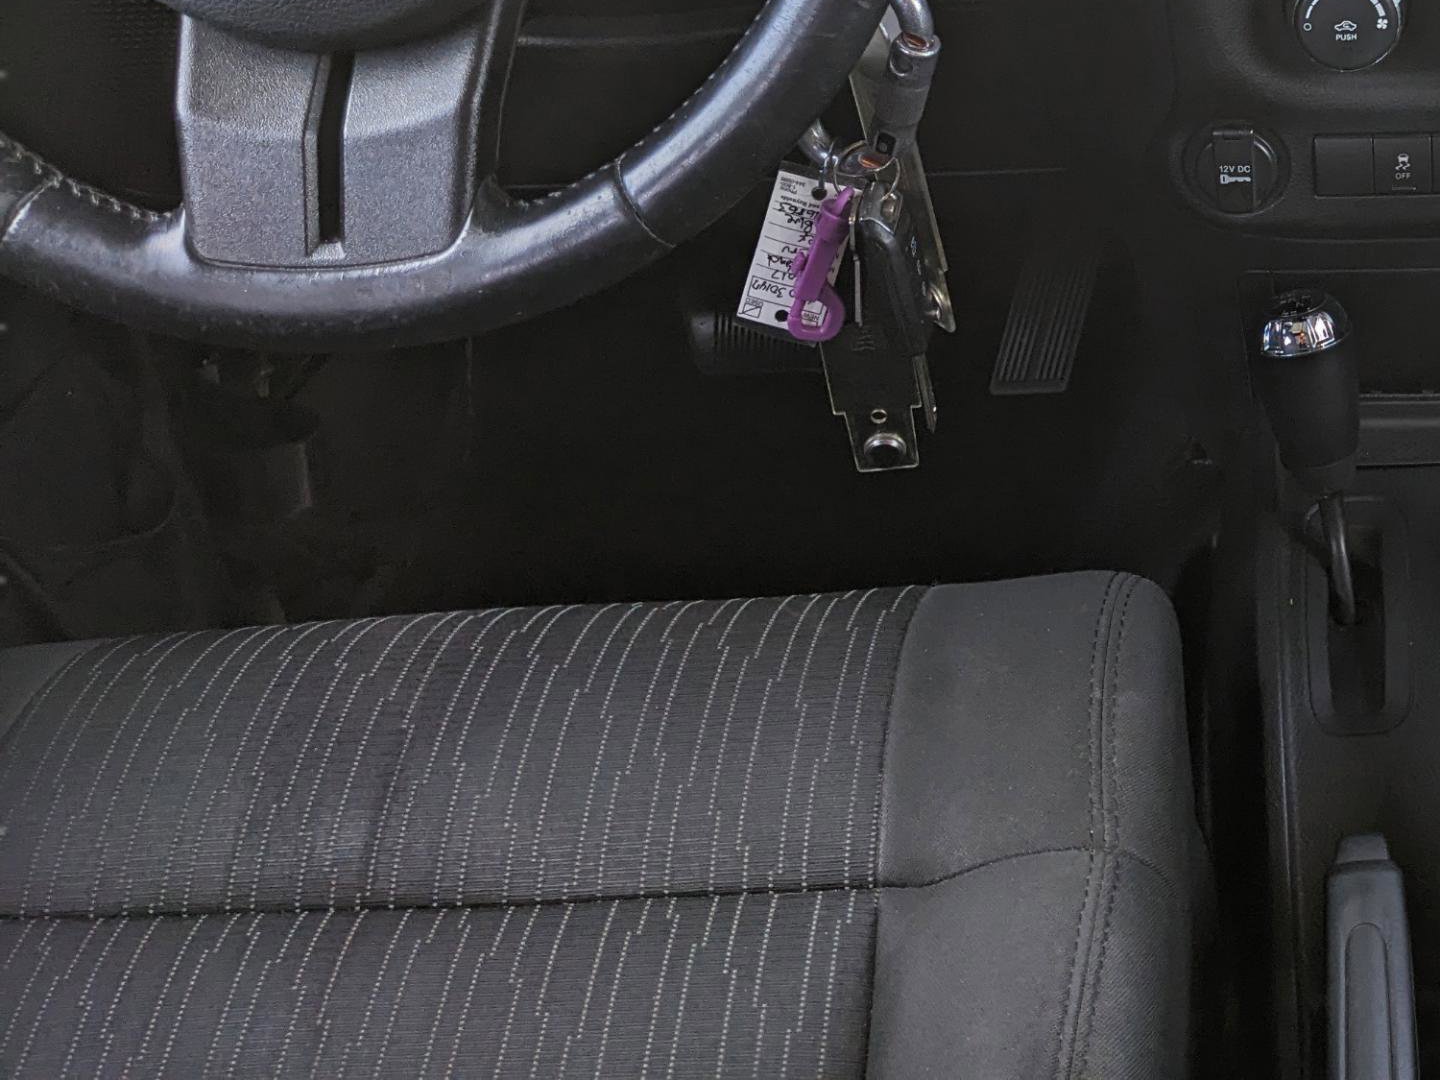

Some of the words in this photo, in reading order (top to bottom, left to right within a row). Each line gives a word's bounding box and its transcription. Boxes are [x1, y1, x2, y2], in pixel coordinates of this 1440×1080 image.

[1219, 165, 1235, 173] 12V
[1238, 165, 1251, 173] DC
[1395, 172, 1411, 180] OFF
